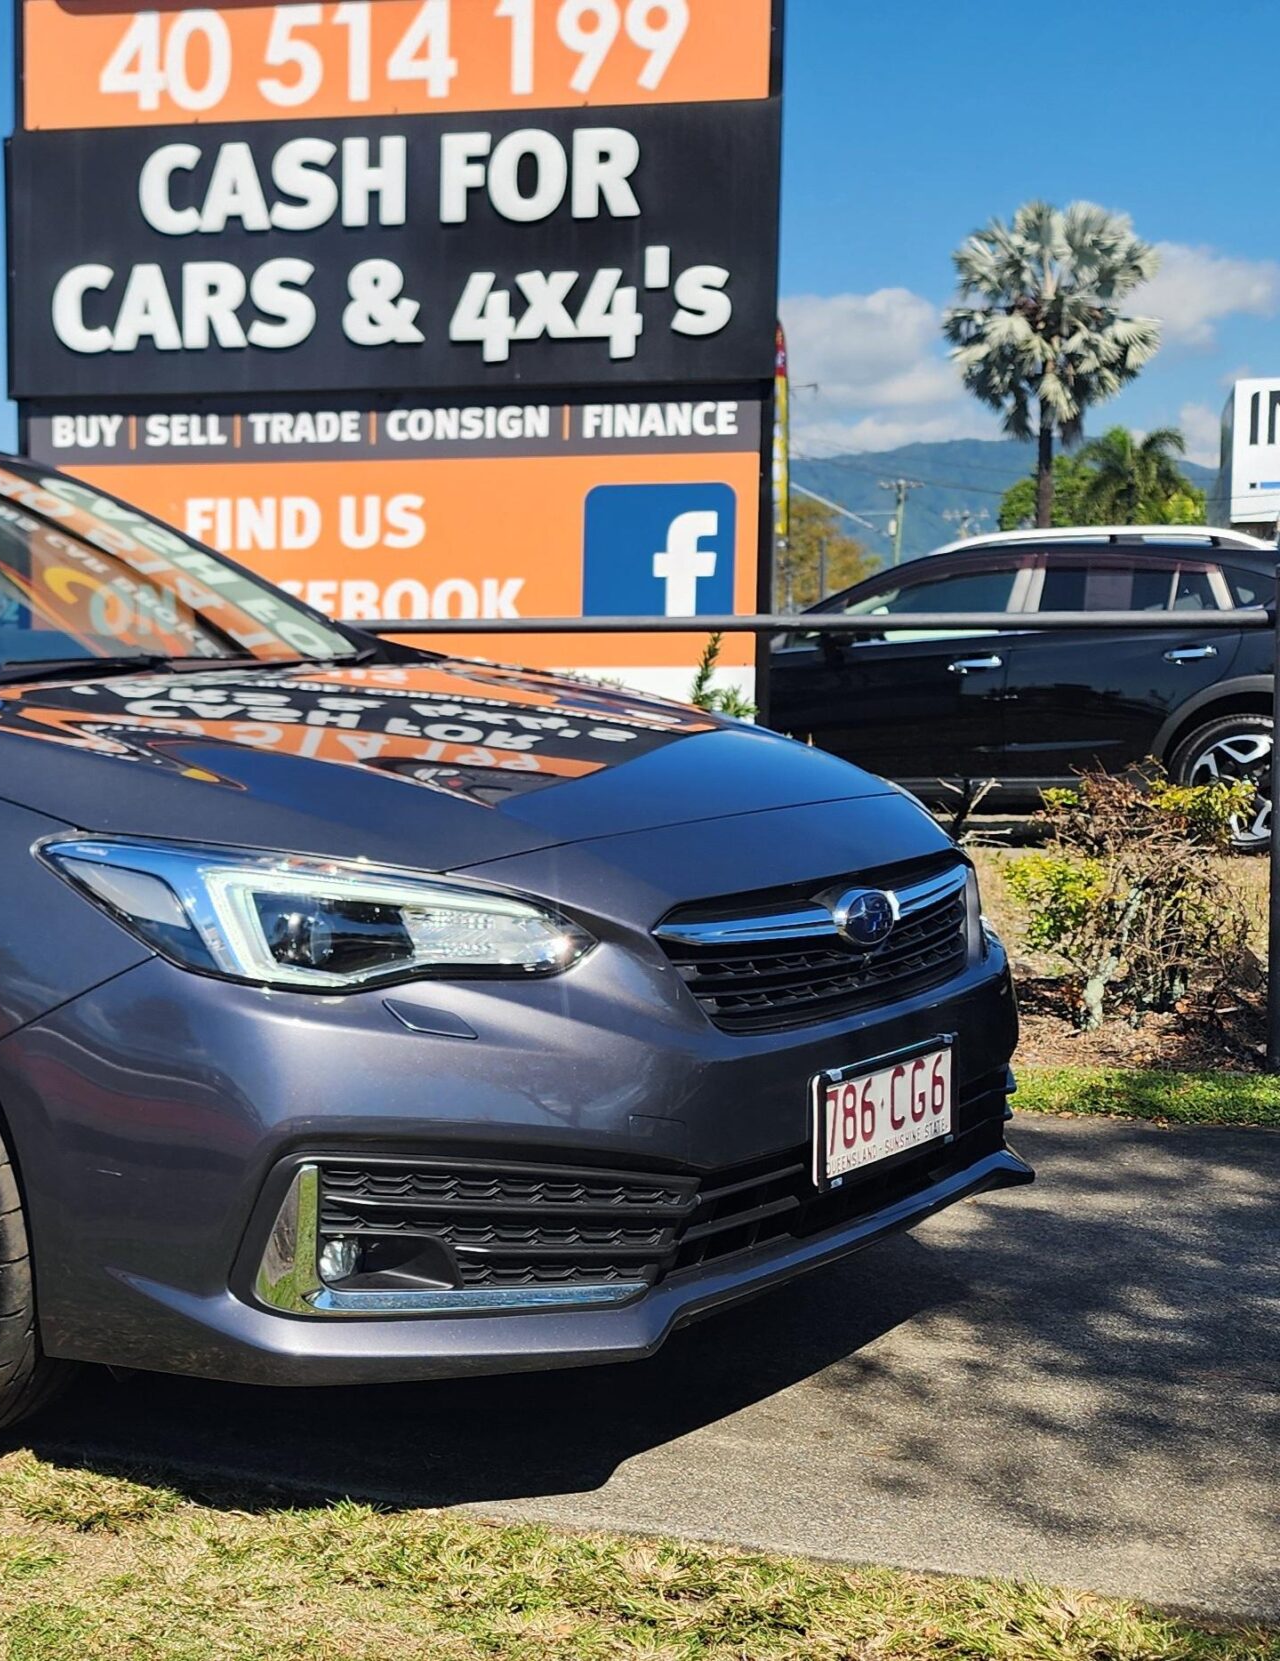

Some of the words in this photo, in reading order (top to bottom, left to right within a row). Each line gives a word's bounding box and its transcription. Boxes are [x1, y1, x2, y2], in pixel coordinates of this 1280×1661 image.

[100, 9, 232, 111] 40
[257, 0, 458, 106] 514
[494, 0, 690, 95] 199
[139, 135, 407, 235] CASH
[439, 127, 641, 224] FOR
[52, 257, 316, 353] CARS
[342, 258, 425, 346] &
[51, 414, 123, 448] BUY
[145, 413, 228, 447] SELL
[248, 410, 362, 444] TRADE
[385, 404, 550, 441] CONSIGN
[582, 401, 739, 438] FINANCE
[184, 496, 322, 551] FIND
[338, 494, 427, 549] US
[89, 582, 178, 636] ON
[277, 578, 526, 620] EBOOK
